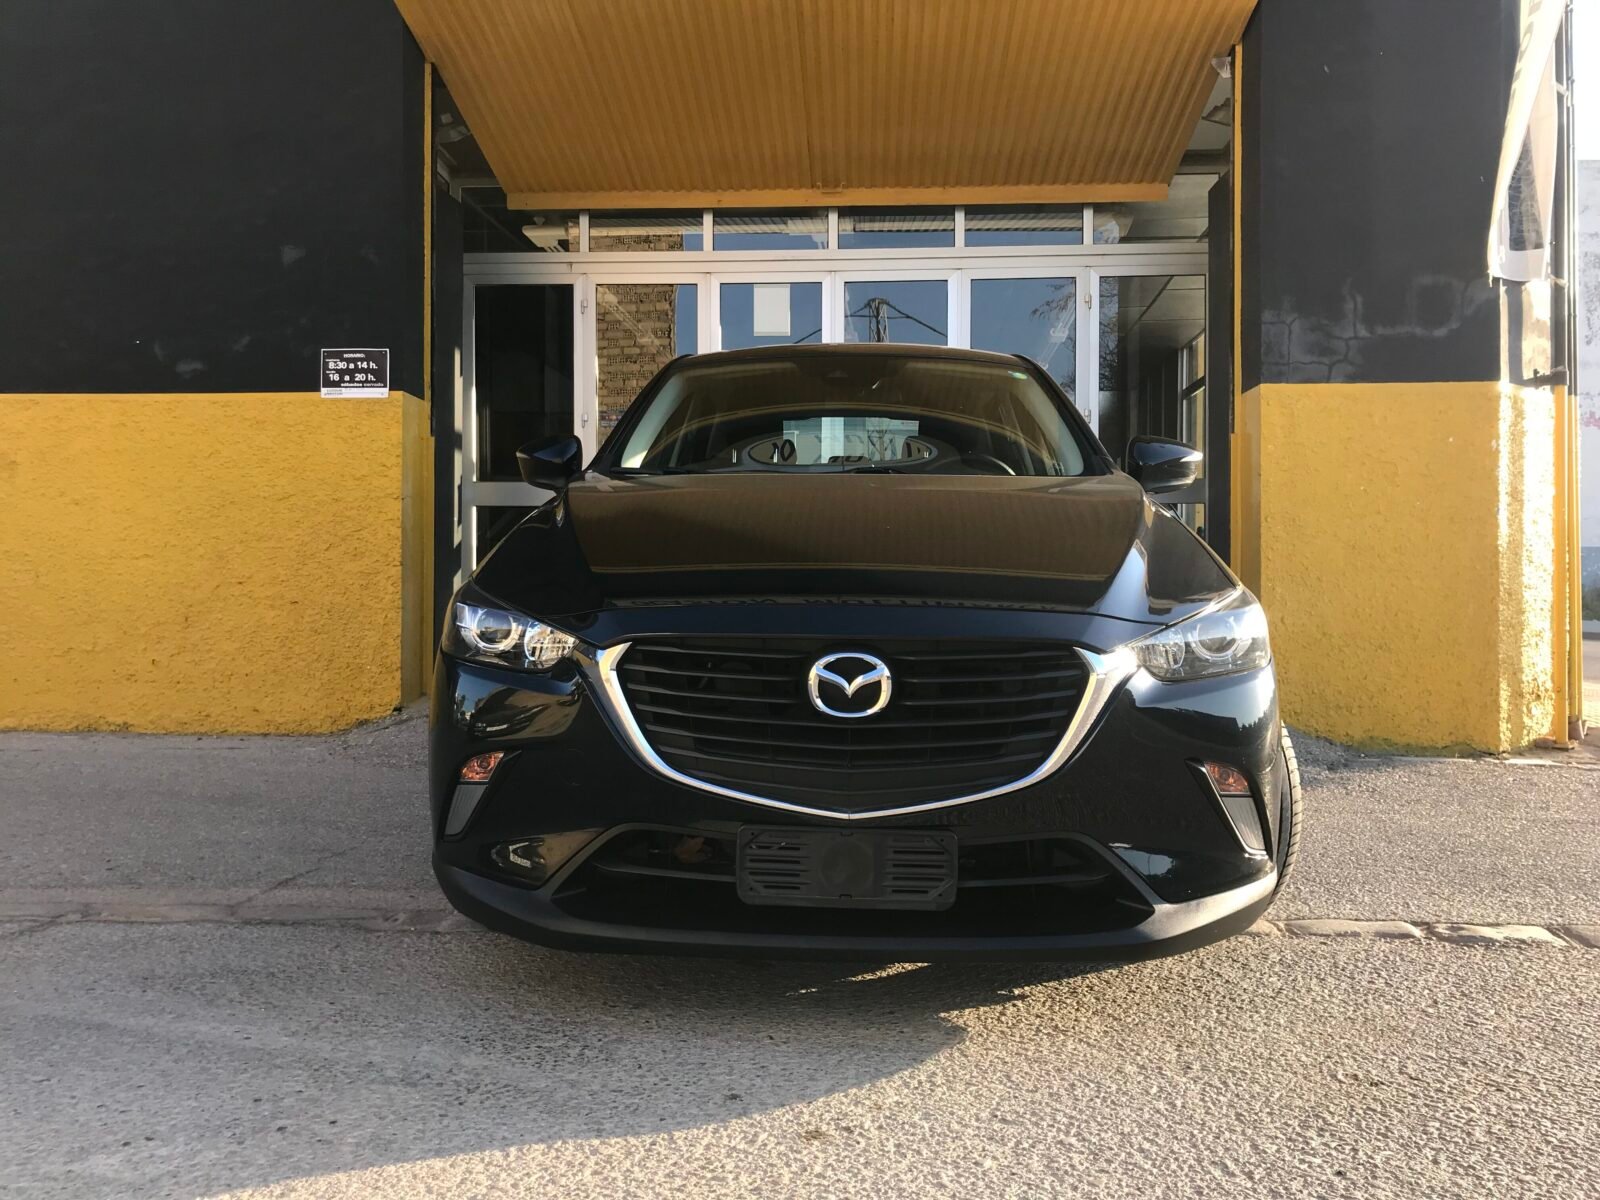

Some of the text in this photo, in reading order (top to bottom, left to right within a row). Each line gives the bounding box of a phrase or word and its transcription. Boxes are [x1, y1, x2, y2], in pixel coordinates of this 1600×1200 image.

[328, 361, 347, 369] 8:30
[357, 361, 368, 369] 14
[369, 361, 378, 369] h.
[329, 373, 340, 381] 16
[354, 373, 366, 381] 20
[367, 373, 377, 381] h.
